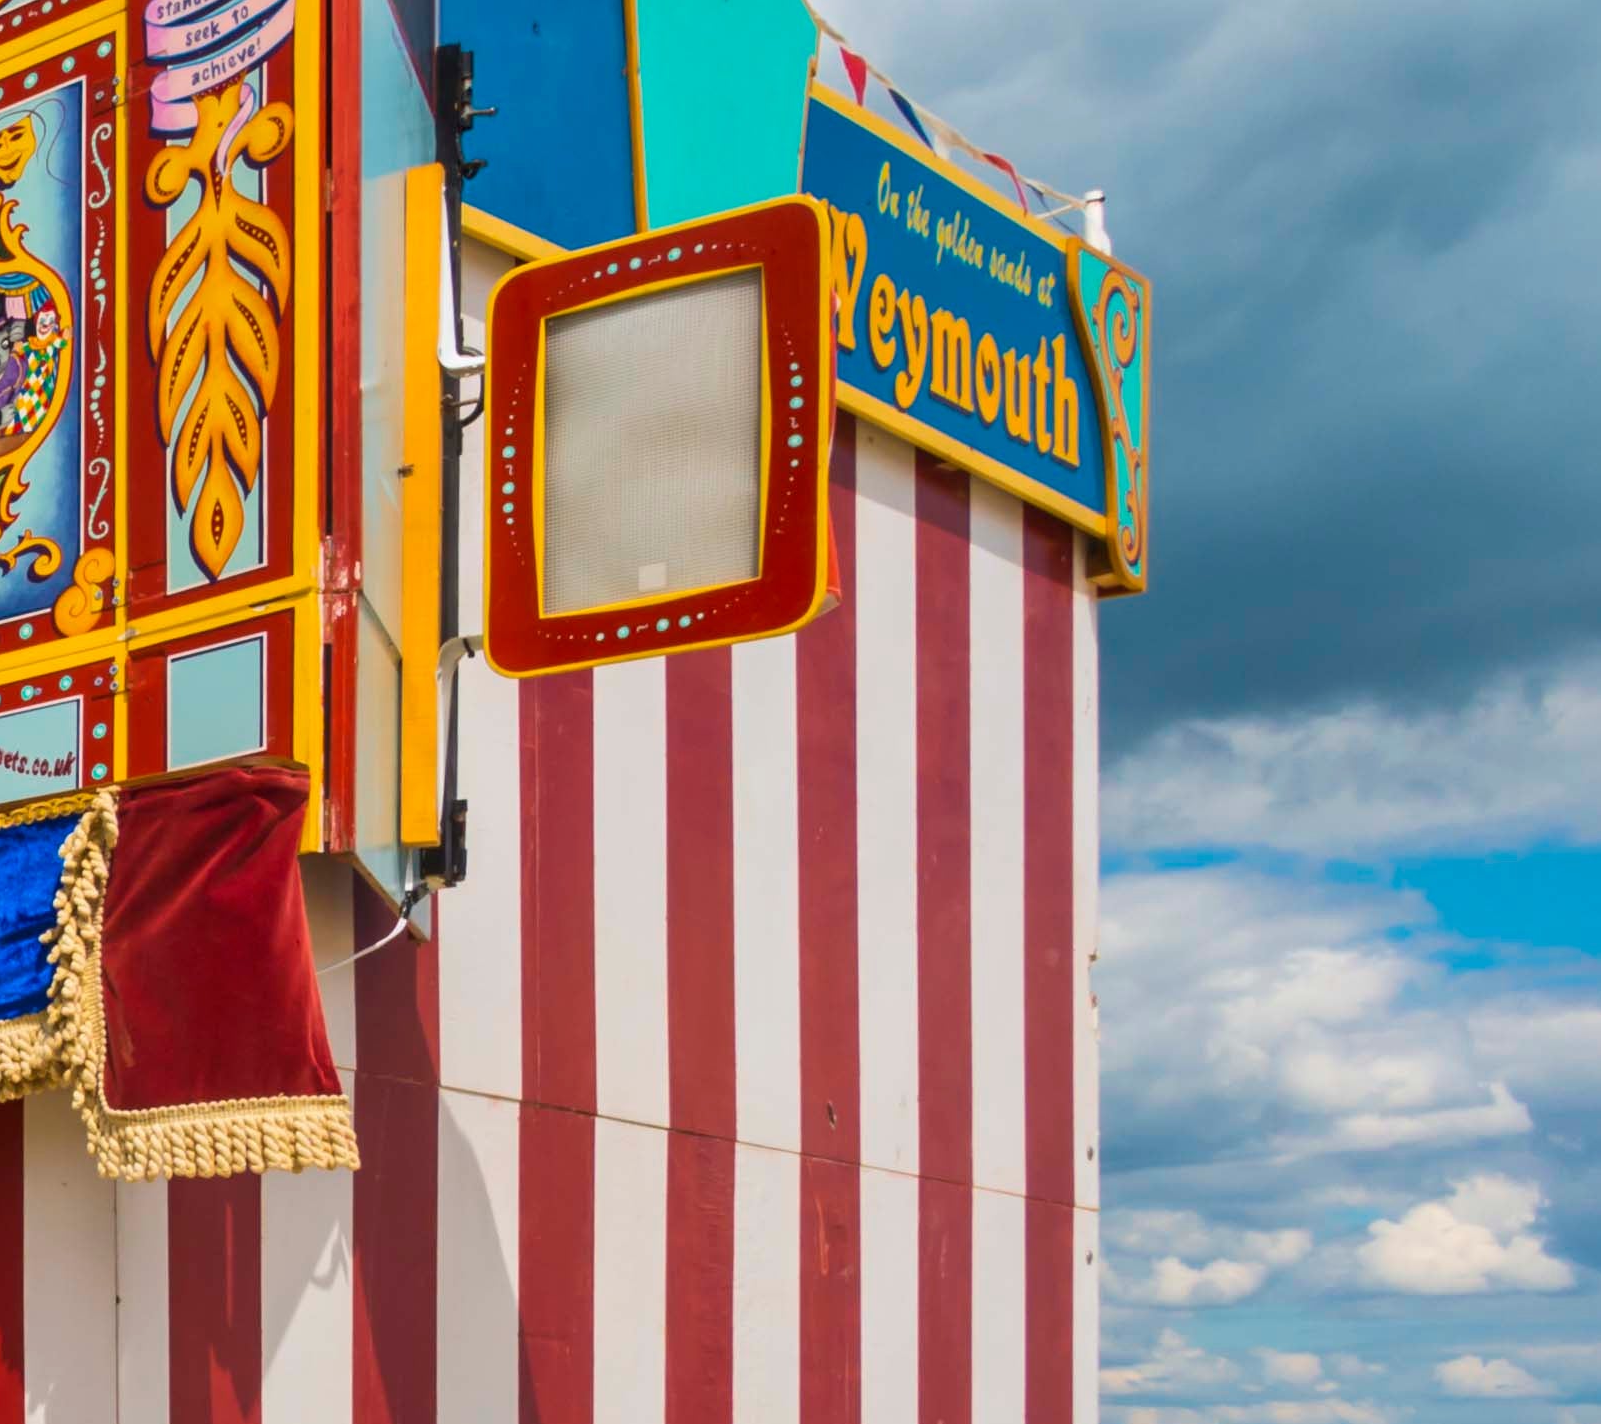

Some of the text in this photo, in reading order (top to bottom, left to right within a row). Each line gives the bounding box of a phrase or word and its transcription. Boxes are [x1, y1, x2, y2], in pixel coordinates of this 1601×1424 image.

[185, 5, 249, 48] seek to
[191, 37, 262, 87] achieve!
[877, 161, 1056, 308] On the golden sands at
[825, 201, 1080, 468] Weymouth
